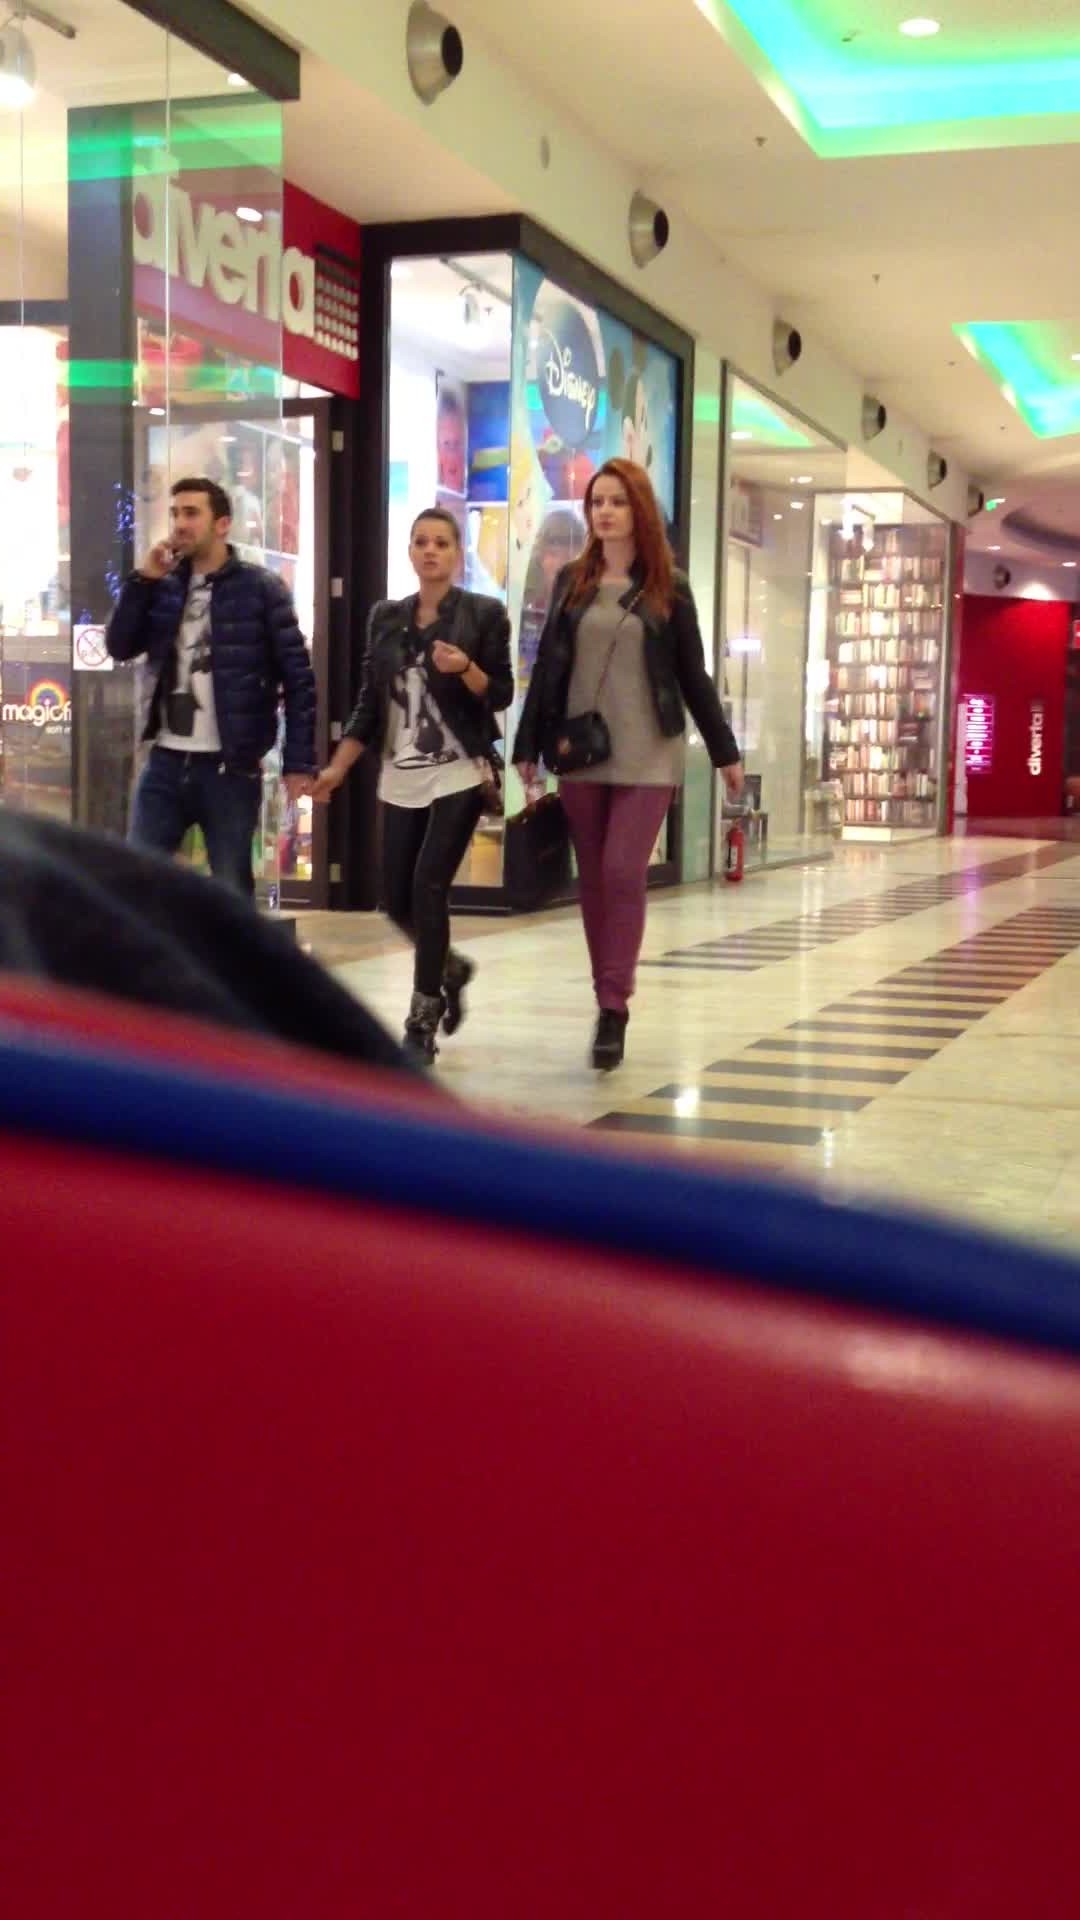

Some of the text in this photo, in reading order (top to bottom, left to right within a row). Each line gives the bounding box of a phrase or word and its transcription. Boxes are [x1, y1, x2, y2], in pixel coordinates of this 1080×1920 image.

[133, 148, 315, 338] diverta
[544, 330, 595, 431] Disney
[1027, 713, 1043, 775] diverta
